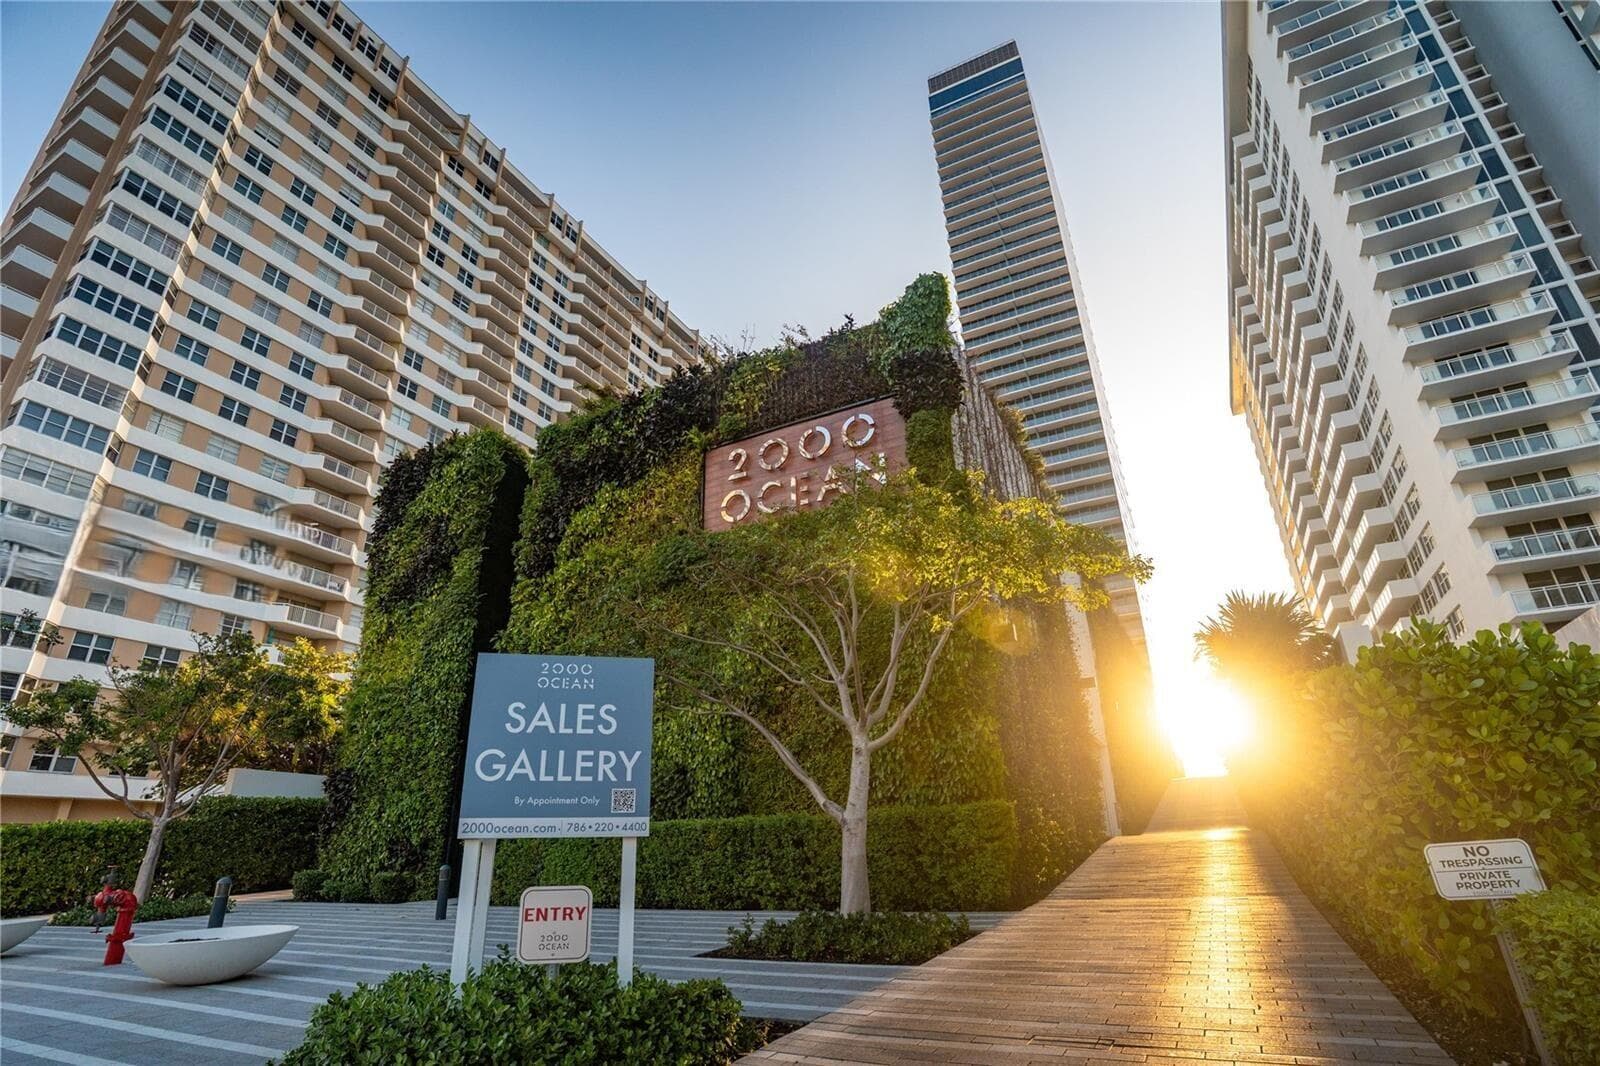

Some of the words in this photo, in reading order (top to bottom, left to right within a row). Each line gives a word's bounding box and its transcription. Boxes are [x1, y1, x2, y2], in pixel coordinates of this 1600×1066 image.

[728, 413, 875, 481] 2000
[541, 662, 593, 675] 2000
[537, 676, 595, 689] OCEAN
[505, 702, 618, 735] SALES
[474, 748, 642, 782] GALLERY
[514, 796, 524, 806] By
[527, 796, 578, 806] Appointment
[580, 795, 600, 806] Only
[462, 822, 557, 834] 2000ocean.com
[1462, 845, 1490, 858] NO
[1440, 856, 1523, 869] TRESPASSING
[1459, 870, 1512, 881] PRIVATE
[1456, 880, 1521, 891] PROPERTY
[524, 906, 587, 922] ENTRY
[540, 934, 569, 942] 2000
[538, 943, 570, 951] OCEAN
